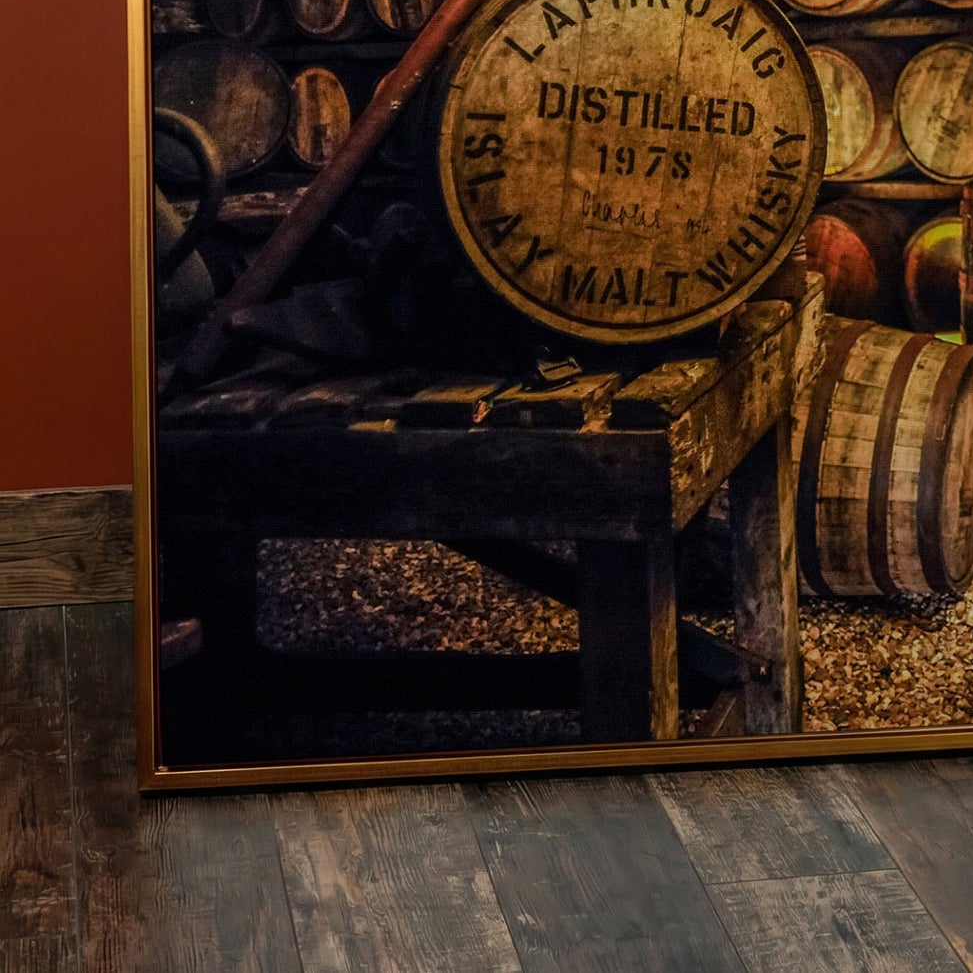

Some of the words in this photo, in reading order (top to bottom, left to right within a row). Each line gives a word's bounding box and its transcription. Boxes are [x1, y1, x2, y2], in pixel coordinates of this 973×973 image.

[538, 81, 756, 137] DISTILLED
[562, 265, 690, 308] MALT
[700, 125, 806, 292] WHISKY
